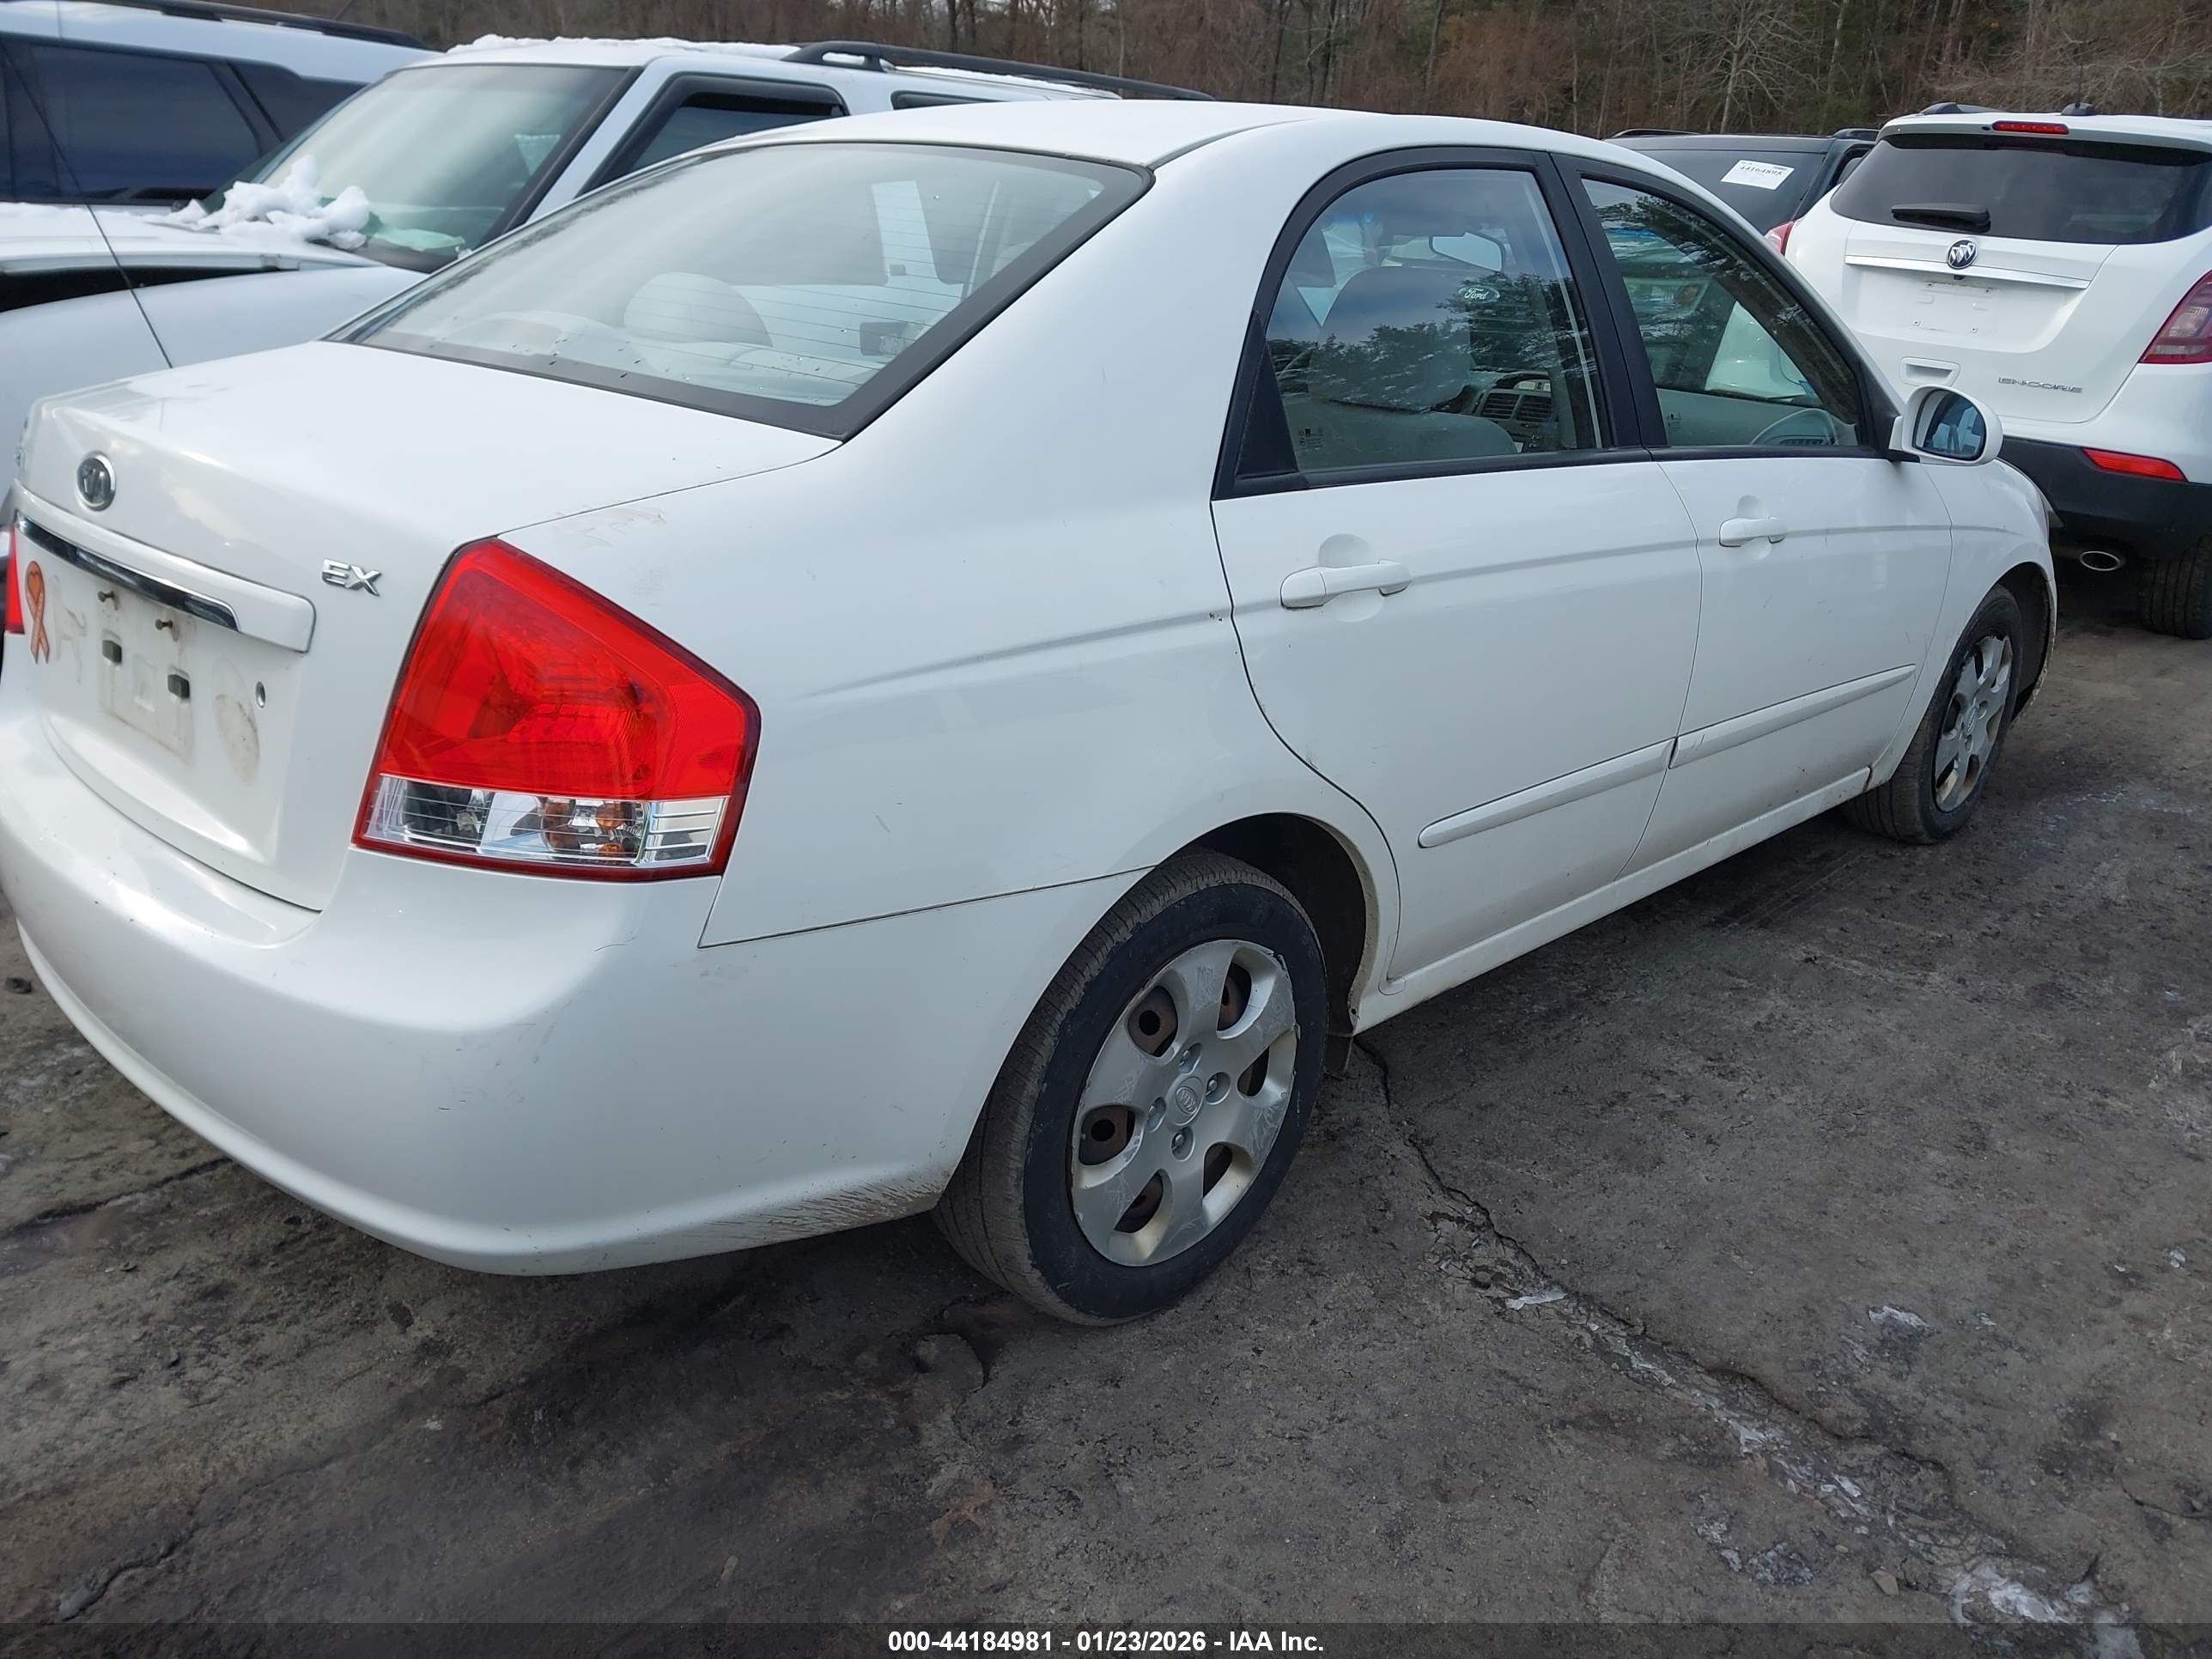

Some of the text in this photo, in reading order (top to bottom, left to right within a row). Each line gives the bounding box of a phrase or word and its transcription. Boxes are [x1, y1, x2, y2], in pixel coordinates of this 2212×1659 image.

[1464, 288, 1490, 300] Ford
[1997, 377, 2082, 394] ENCORE
[321, 558, 382, 597] EX
